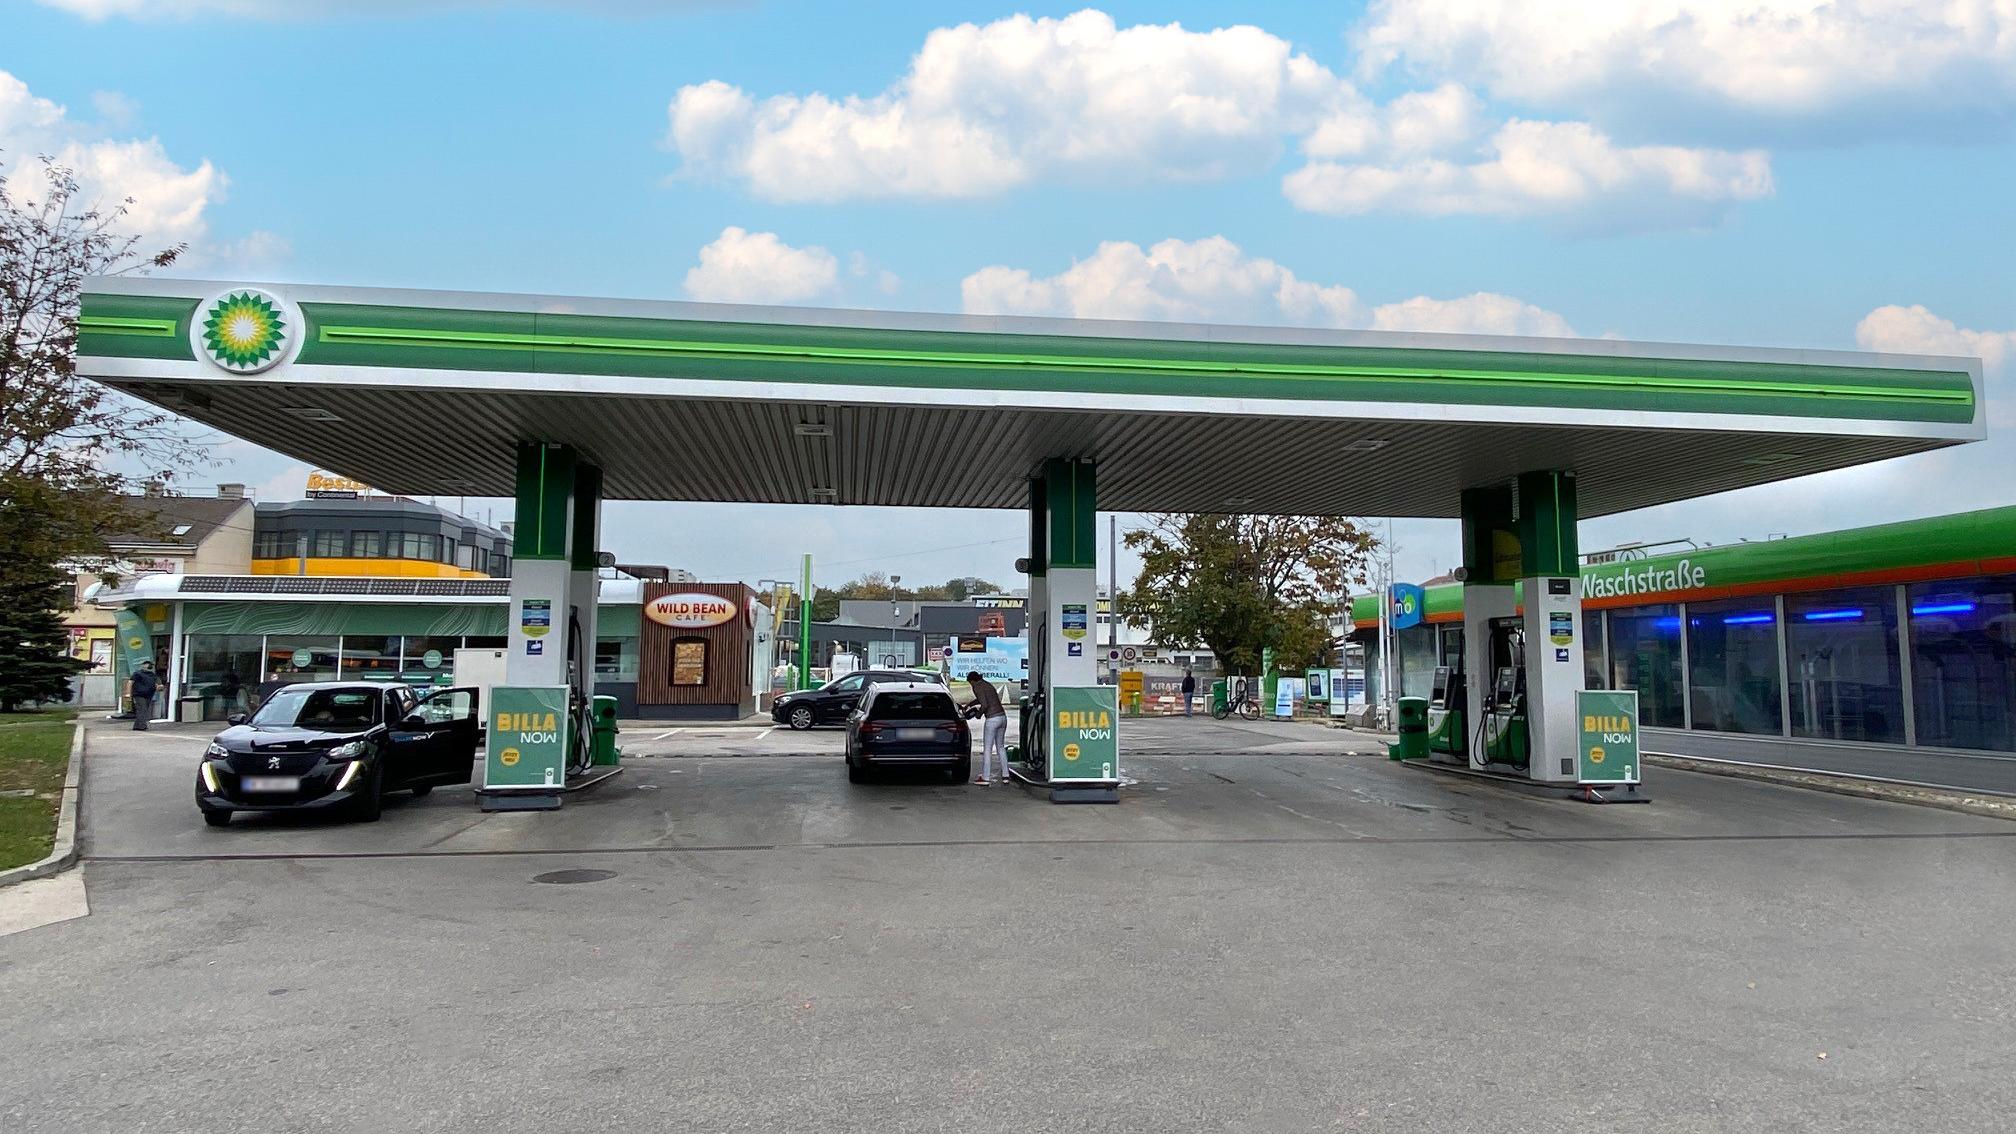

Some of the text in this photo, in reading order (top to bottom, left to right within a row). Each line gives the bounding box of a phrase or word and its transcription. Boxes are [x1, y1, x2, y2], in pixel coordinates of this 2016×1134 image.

[657, 603, 726, 614] WILD BEAN
[497, 713, 557, 731] BILLA
[1058, 711, 1110, 729] BILLA
[1584, 716, 1631, 733] BILLA
[520, 732, 557, 744] NOW
[1080, 728, 1111, 740] NOW
[1603, 733, 1632, 744] NOW
